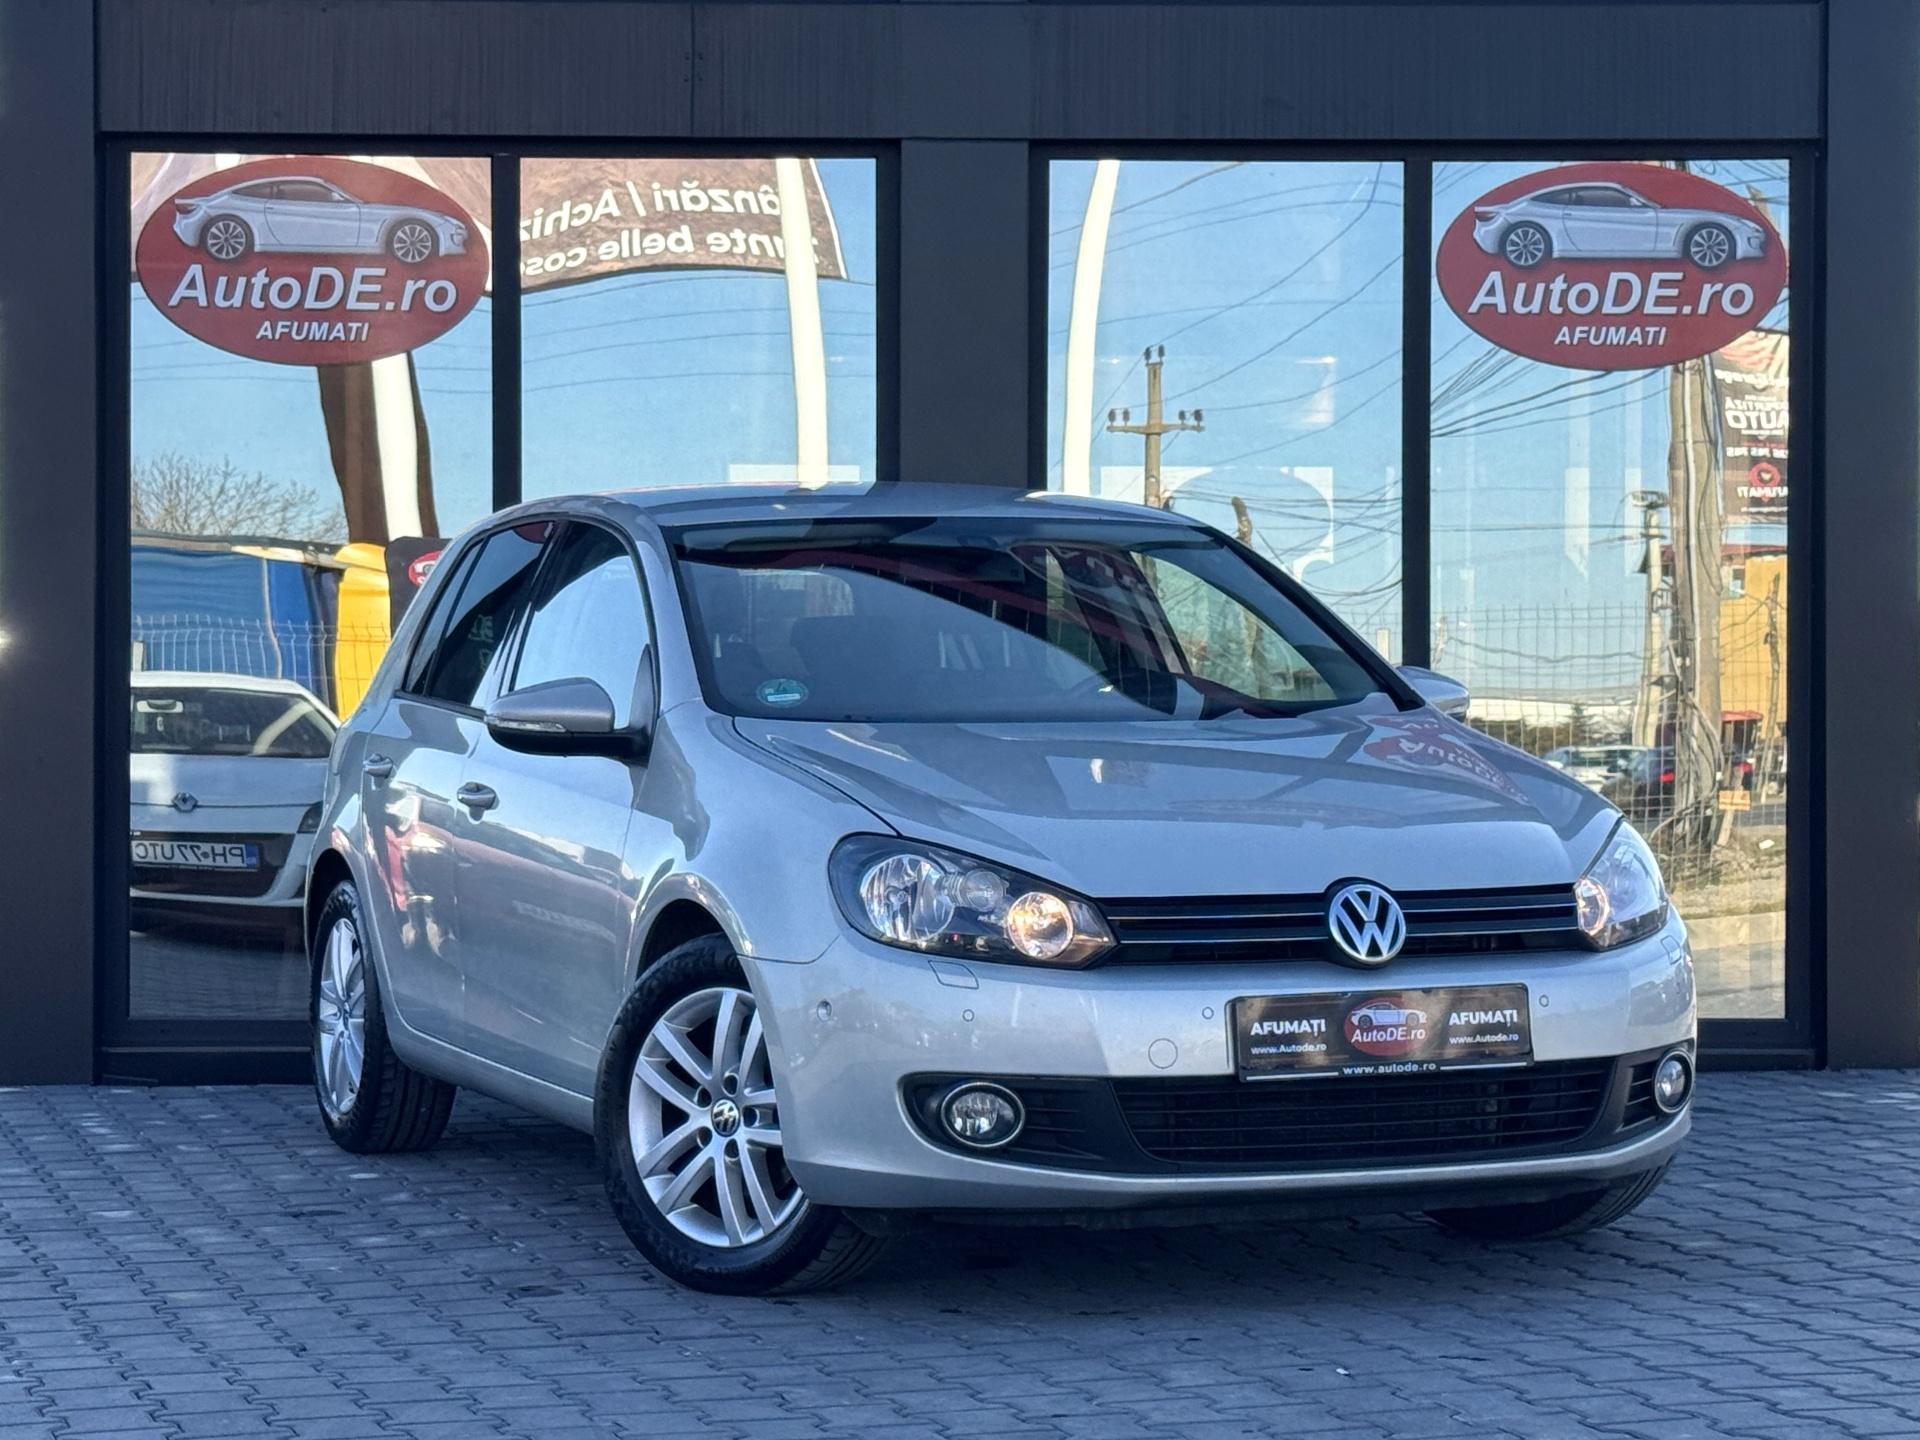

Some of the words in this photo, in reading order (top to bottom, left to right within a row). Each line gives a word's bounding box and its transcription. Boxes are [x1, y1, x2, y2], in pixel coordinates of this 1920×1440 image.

[168, 263, 458, 313] AutoDE.ro
[1467, 271, 1755, 316] AutoDE.ro
[256, 321, 370, 342] AFUMATI
[1554, 326, 1668, 346] AFUMATI
[1351, 1026, 1427, 1044] AutoDE.ro
[1342, 1061, 1437, 1075] www.autode.ro
